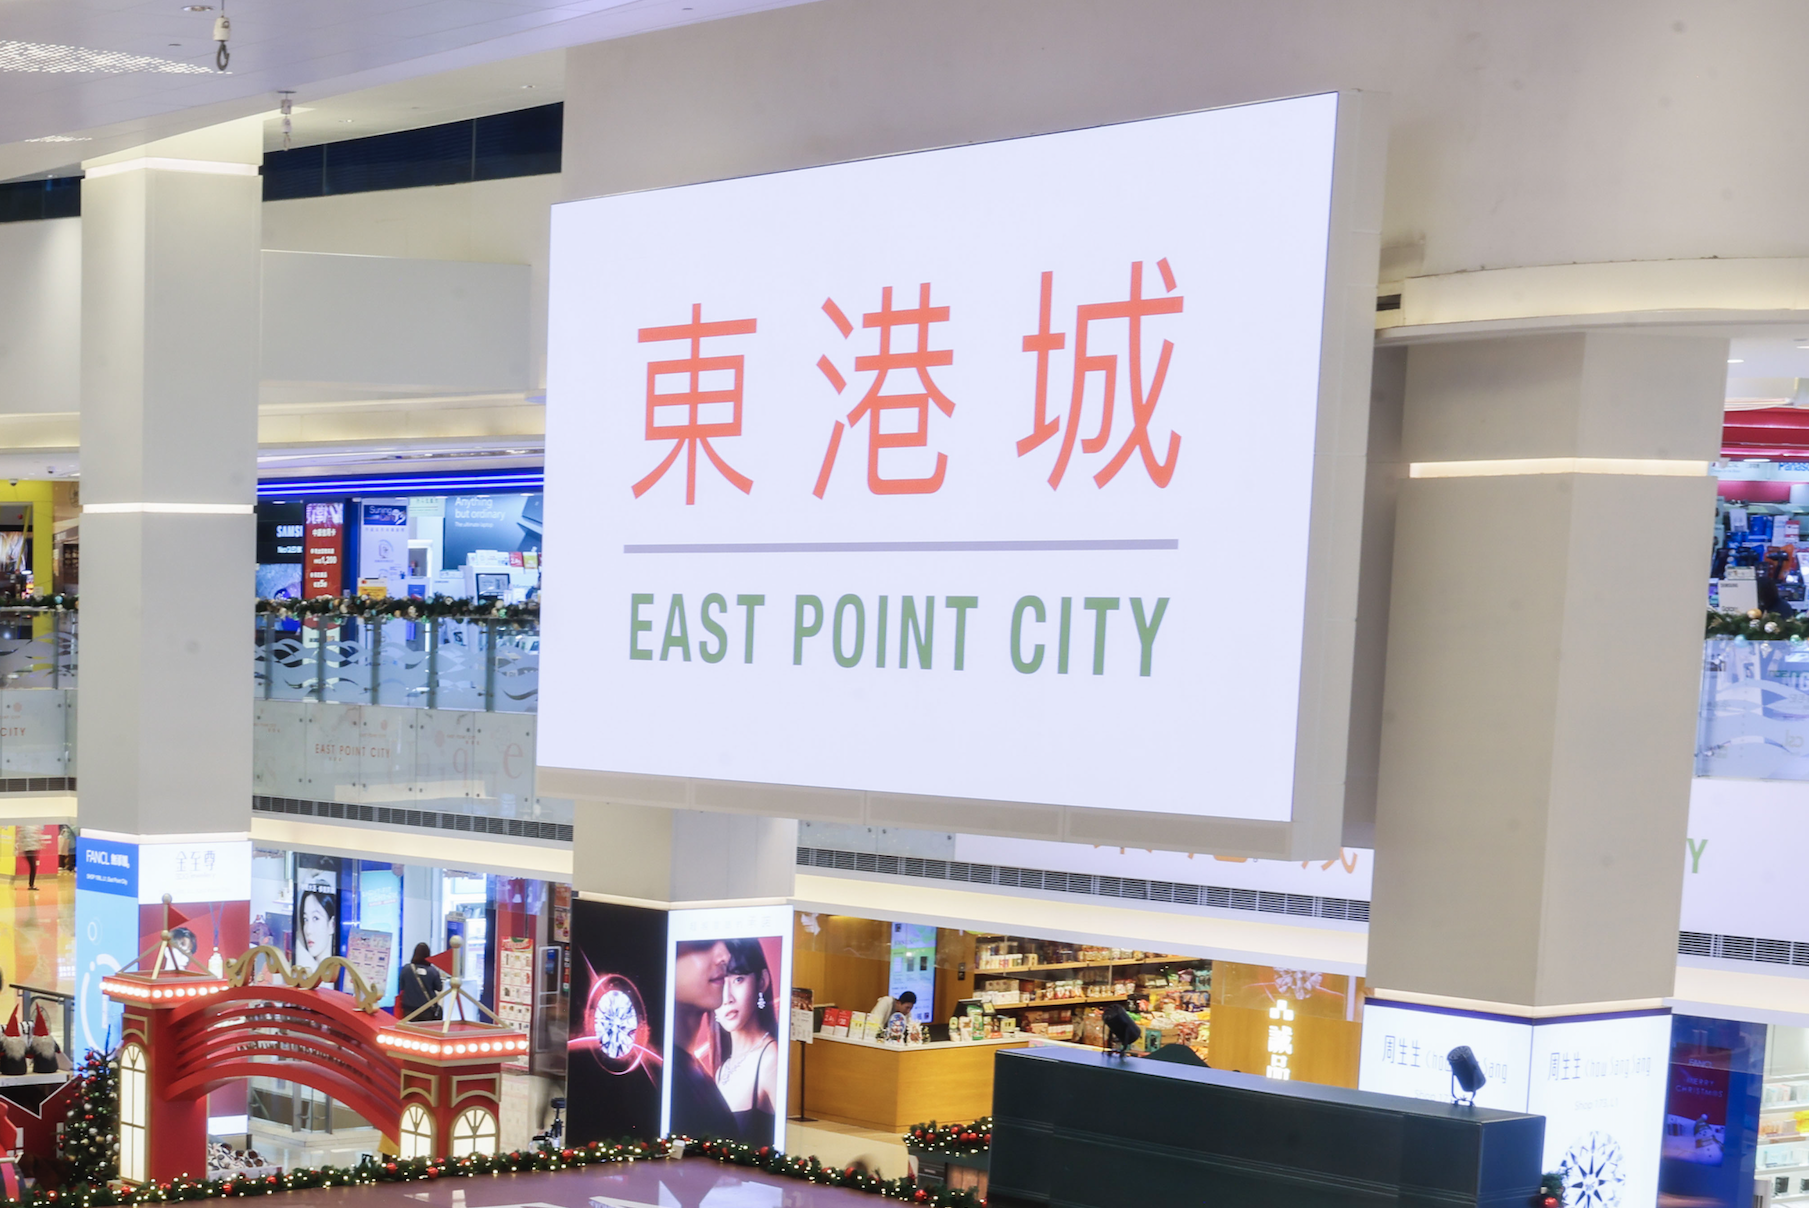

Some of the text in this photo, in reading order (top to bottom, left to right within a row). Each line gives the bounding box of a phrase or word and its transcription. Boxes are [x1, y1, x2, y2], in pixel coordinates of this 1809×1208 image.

[631, 257, 1183, 505] 東港城
[455, 497, 493, 507] Anything
[454, 508, 506, 520] but ordinary
[276, 525, 303, 538] SAMS
[629, 593, 1171, 677] EAST POINT CITY
[0, 727, 26, 738] CITY
[315, 743, 391, 759] EAST POINT CITY
[85, 850, 110, 866] FANCL
[1381, 1034, 1421, 1069] 周生生
[1547, 1051, 1581, 1082] 周生生
[1609, 1055, 1630, 1081] Sang
[1631, 1054, 1652, 1079] Sang
